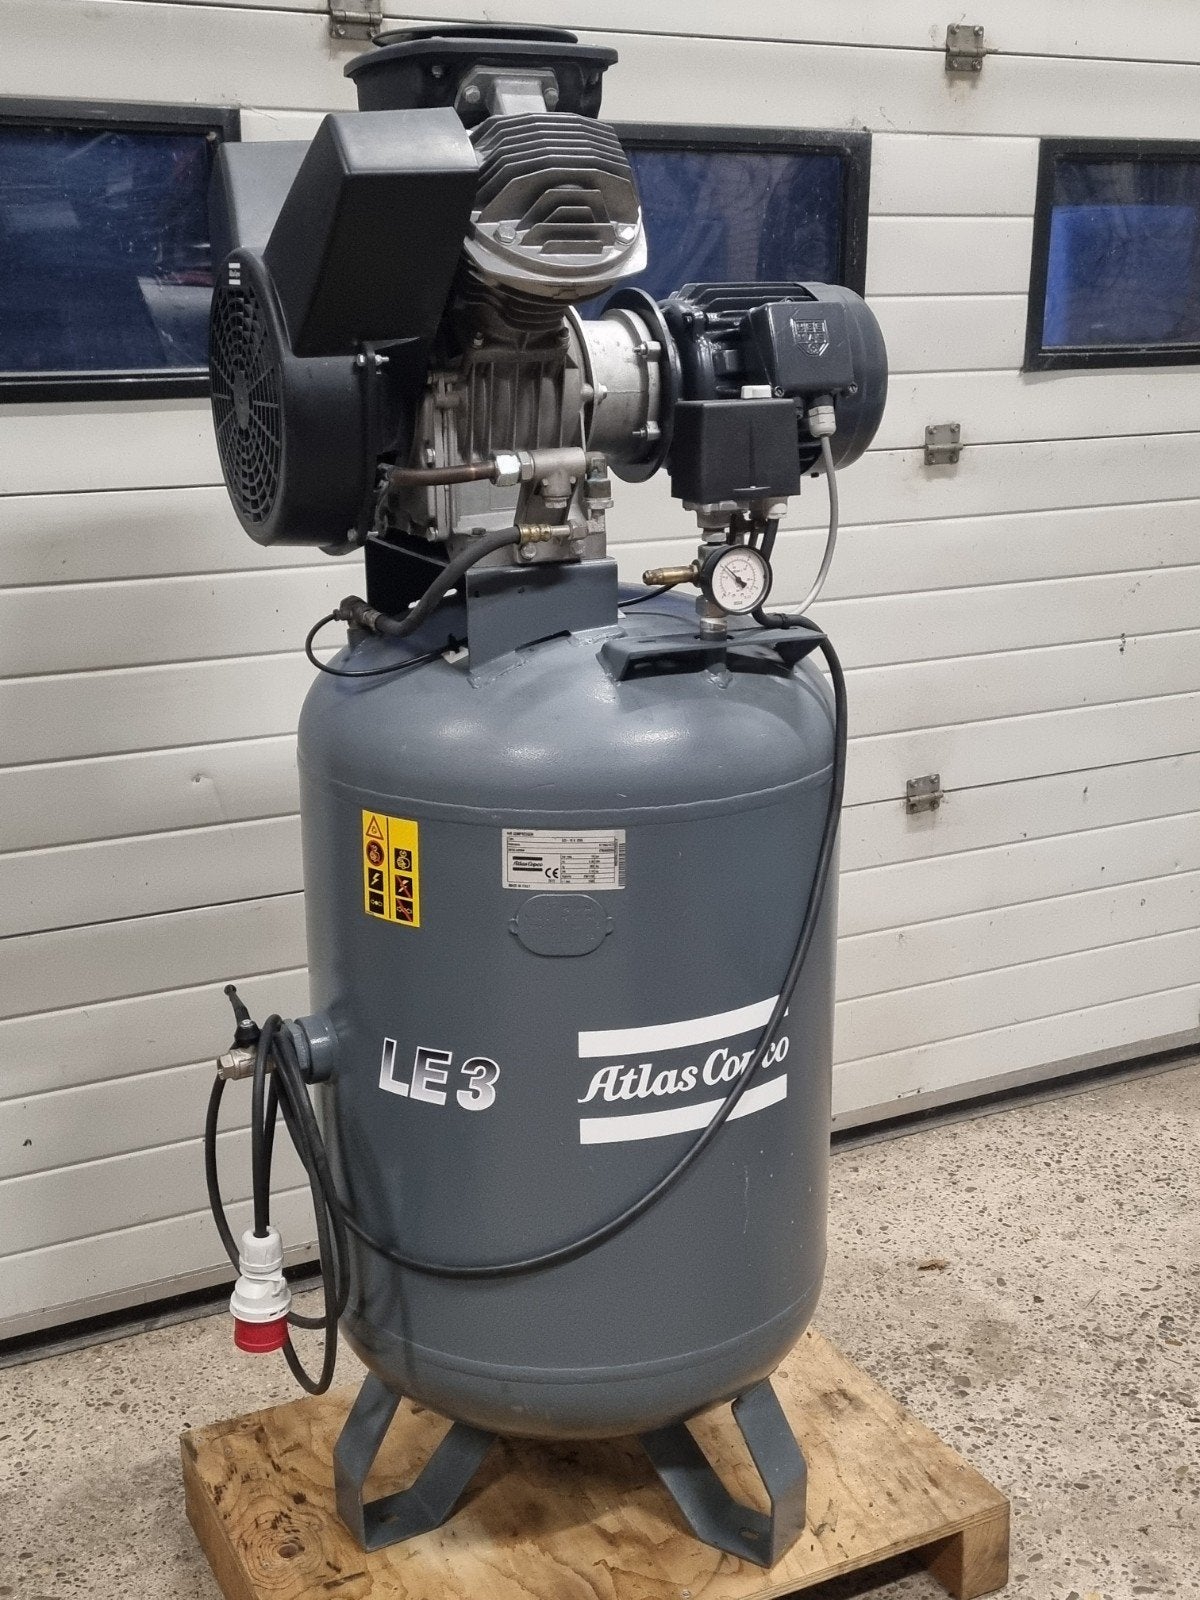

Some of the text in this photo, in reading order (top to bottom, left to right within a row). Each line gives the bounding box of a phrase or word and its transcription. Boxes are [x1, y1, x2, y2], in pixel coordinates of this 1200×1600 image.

[545, 867, 559, 879] CE
[378, 1036, 501, 1112] LE 3
[577, 1063, 698, 1104] Atlas
